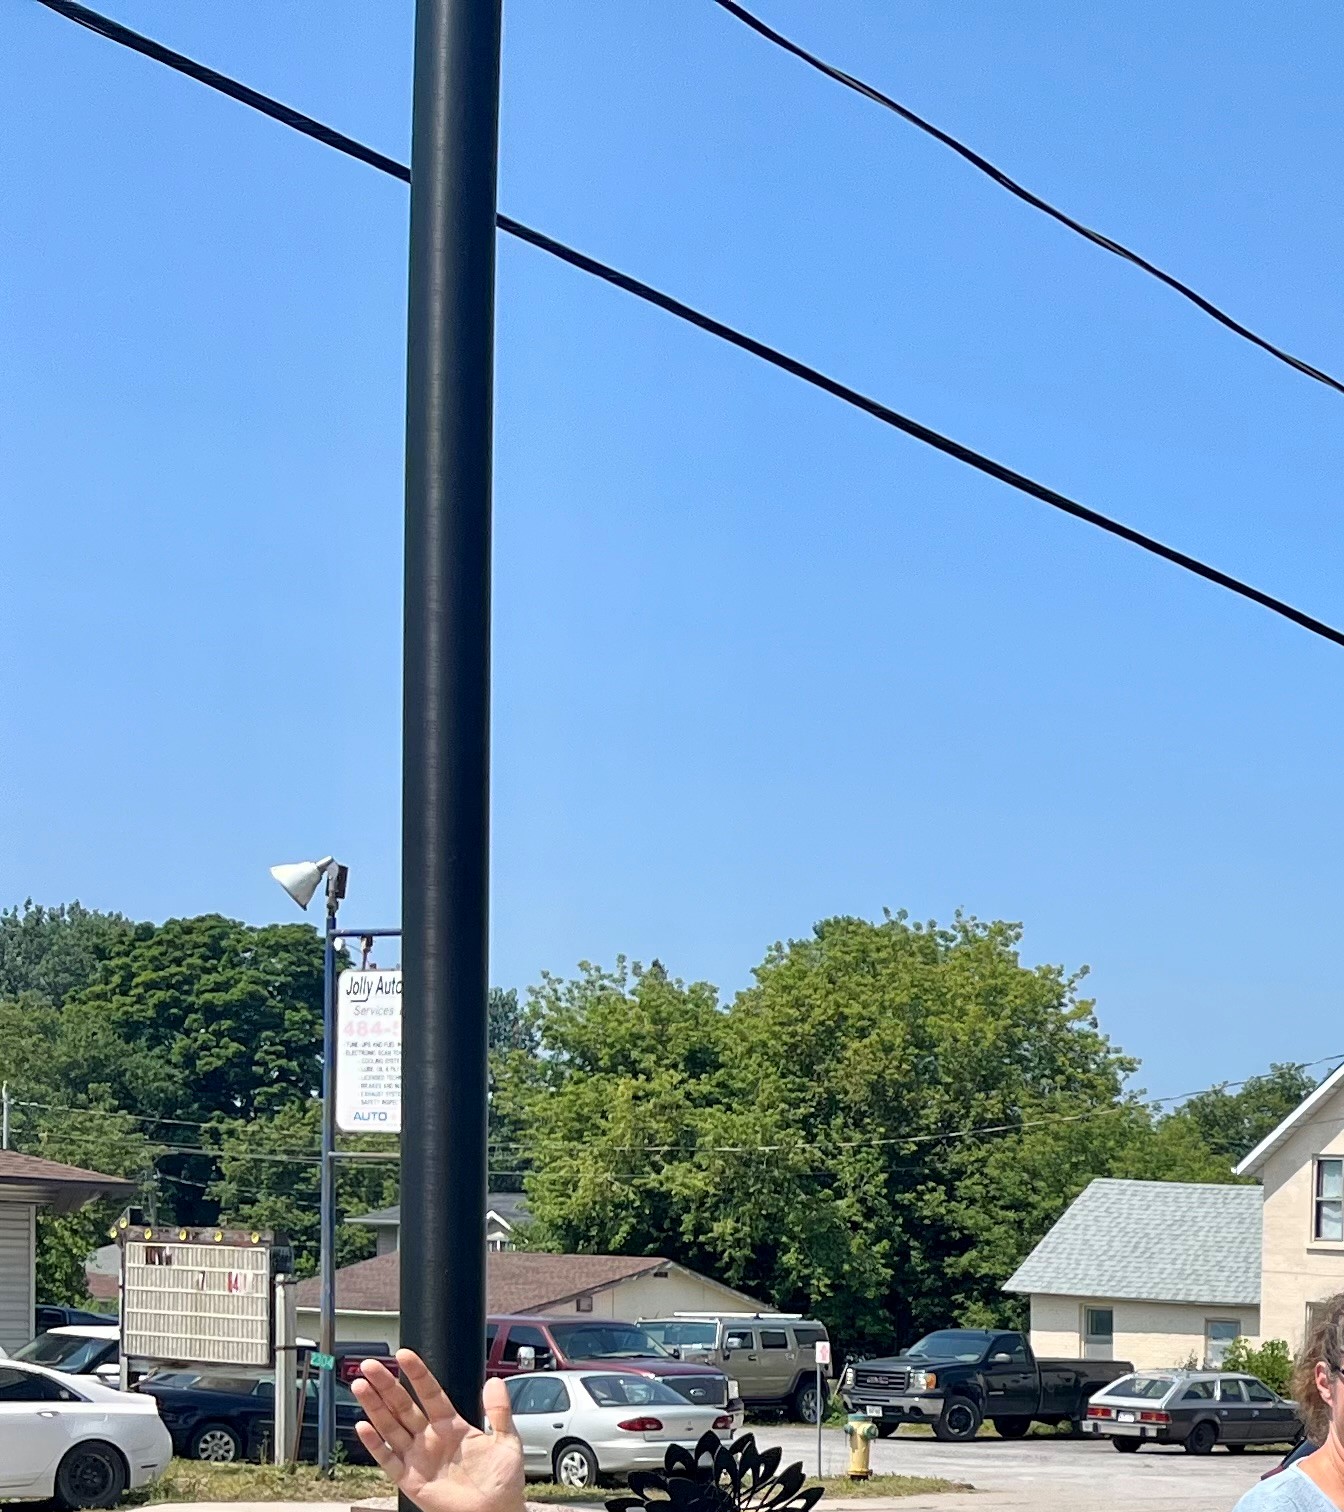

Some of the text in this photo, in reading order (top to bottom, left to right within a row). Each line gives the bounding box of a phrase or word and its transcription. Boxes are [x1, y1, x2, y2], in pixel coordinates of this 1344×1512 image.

[346, 975, 374, 1003] Jolly
[353, 1005, 394, 1017] Services
[353, 1111, 388, 1121] AUTO
